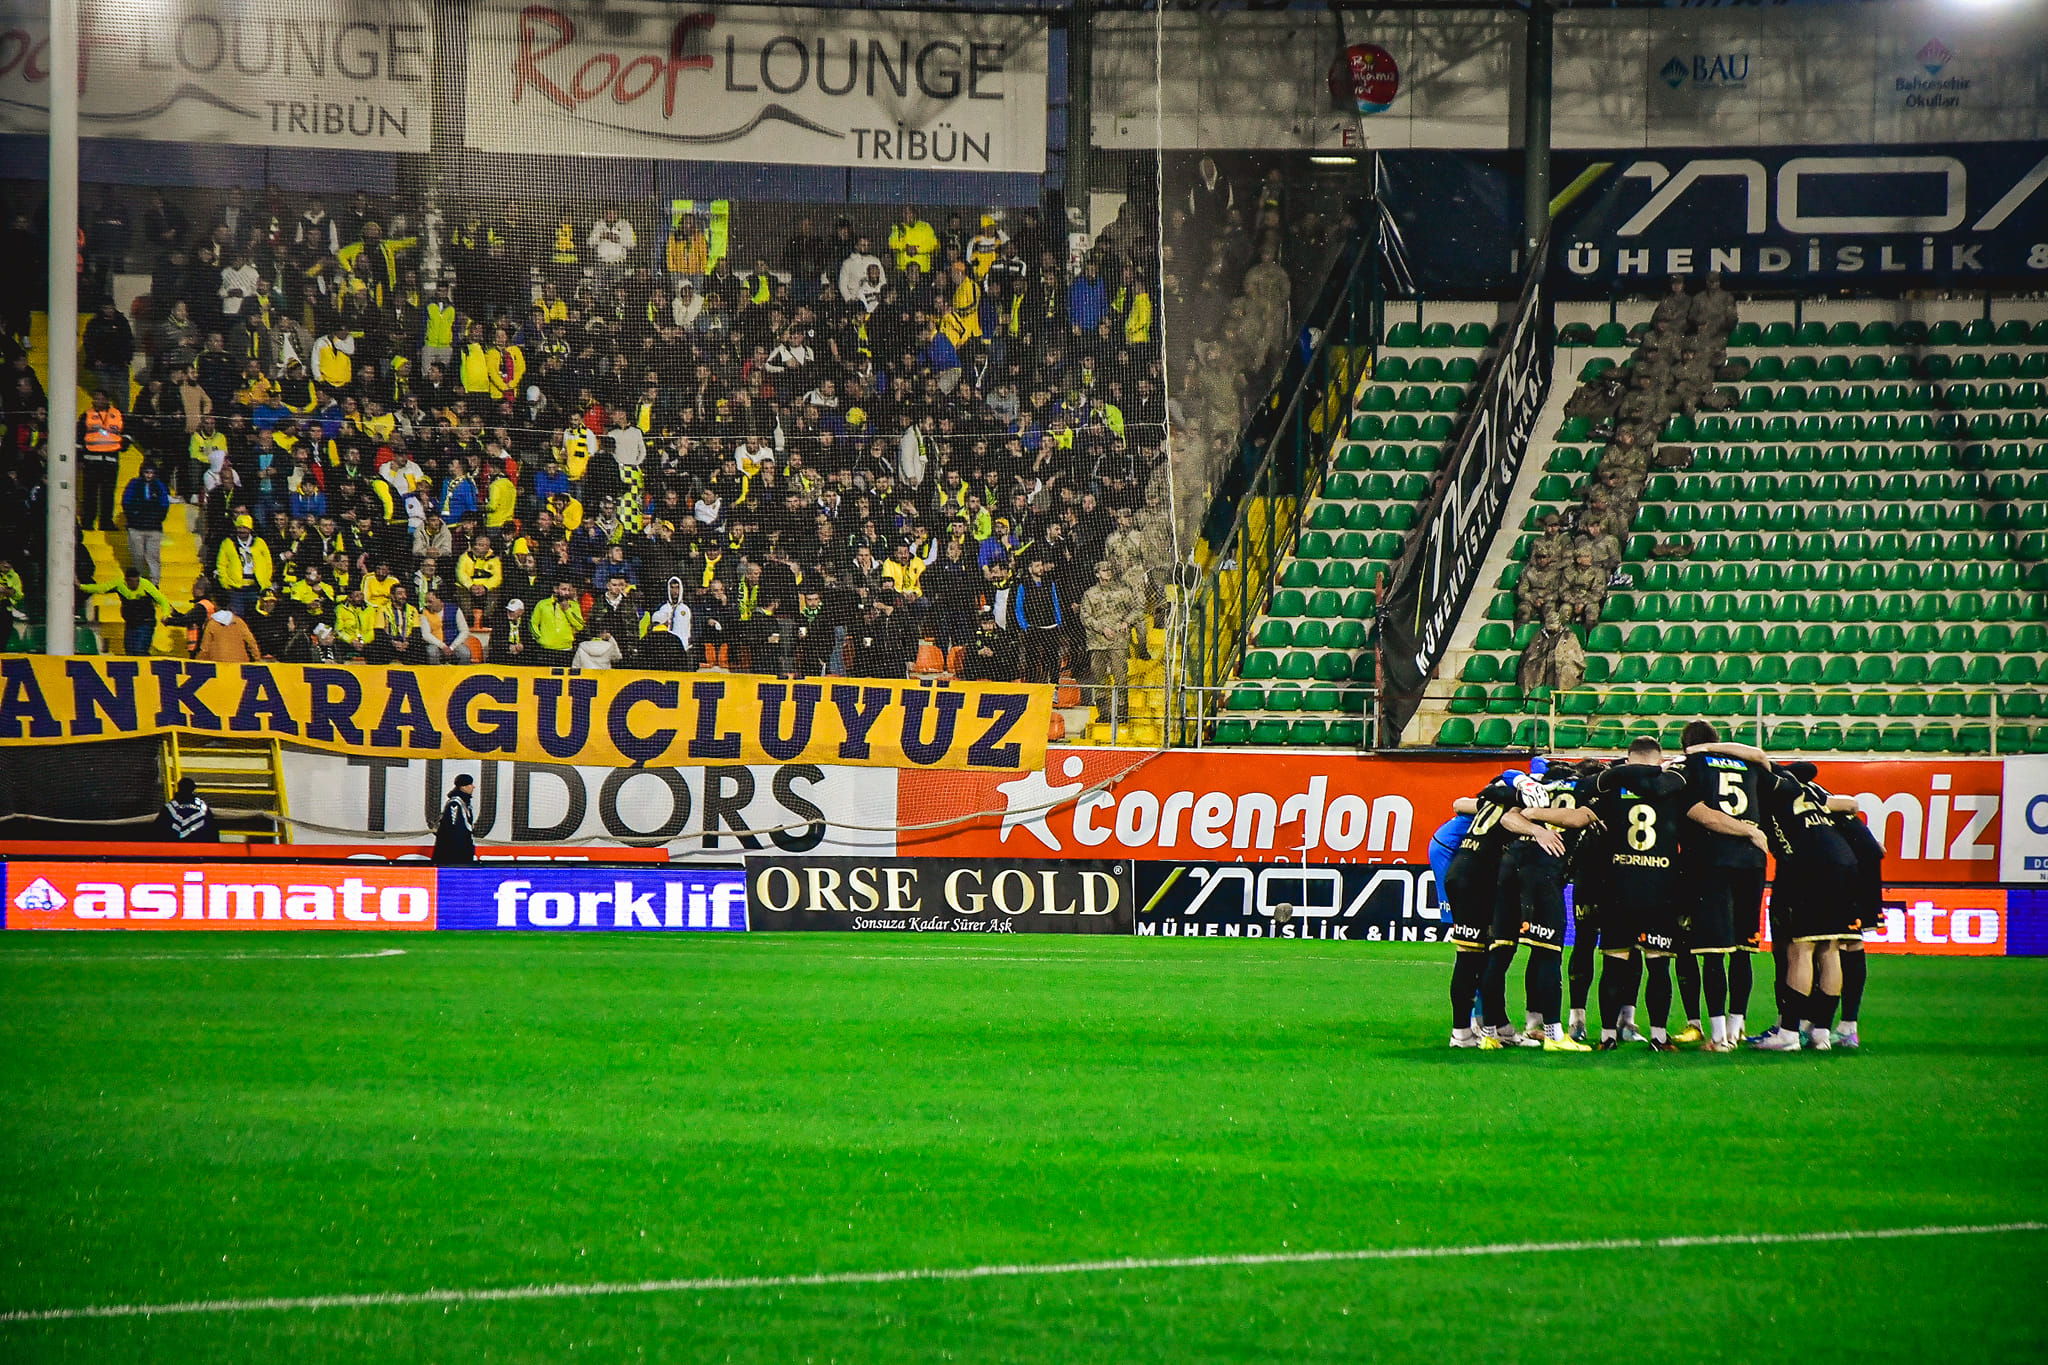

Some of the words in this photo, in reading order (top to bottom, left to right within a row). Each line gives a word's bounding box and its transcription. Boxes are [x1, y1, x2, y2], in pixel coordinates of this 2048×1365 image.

[139, 14, 426, 84] LOUNGE
[512, 4, 715, 119] Roof
[725, 35, 1005, 100] LOUNGE
[1693, 54, 1749, 81] BAU
[266, 97, 408, 138] TRİBÜN
[850, 122, 990, 163] TRİBÜN
[1511, 238, 1983, 274] ÜHENDİSLİK
[346, 756, 826, 853] TUDORS
[1073, 775, 1414, 851] corendon
[1718, 771, 1748, 817] 5
[1627, 803, 1657, 851] 8
[1857, 774, 2000, 860] miz
[1612, 853, 1670, 868] PEDRINHO
[73, 871, 429, 922] asimato
[756, 866, 922, 912] ORSE
[944, 868, 1120, 914] GOLD
[852, 917, 906, 930] Sonsuza
[908, 916, 950, 932] Kadar
[951, 917, 986, 931] Sürer
[1138, 918, 1350, 941] MÜHENDİSLİK
[1454, 923, 1481, 939] tripy
[1529, 921, 1555, 939] tripy
[1647, 933, 1673, 949] tripy
